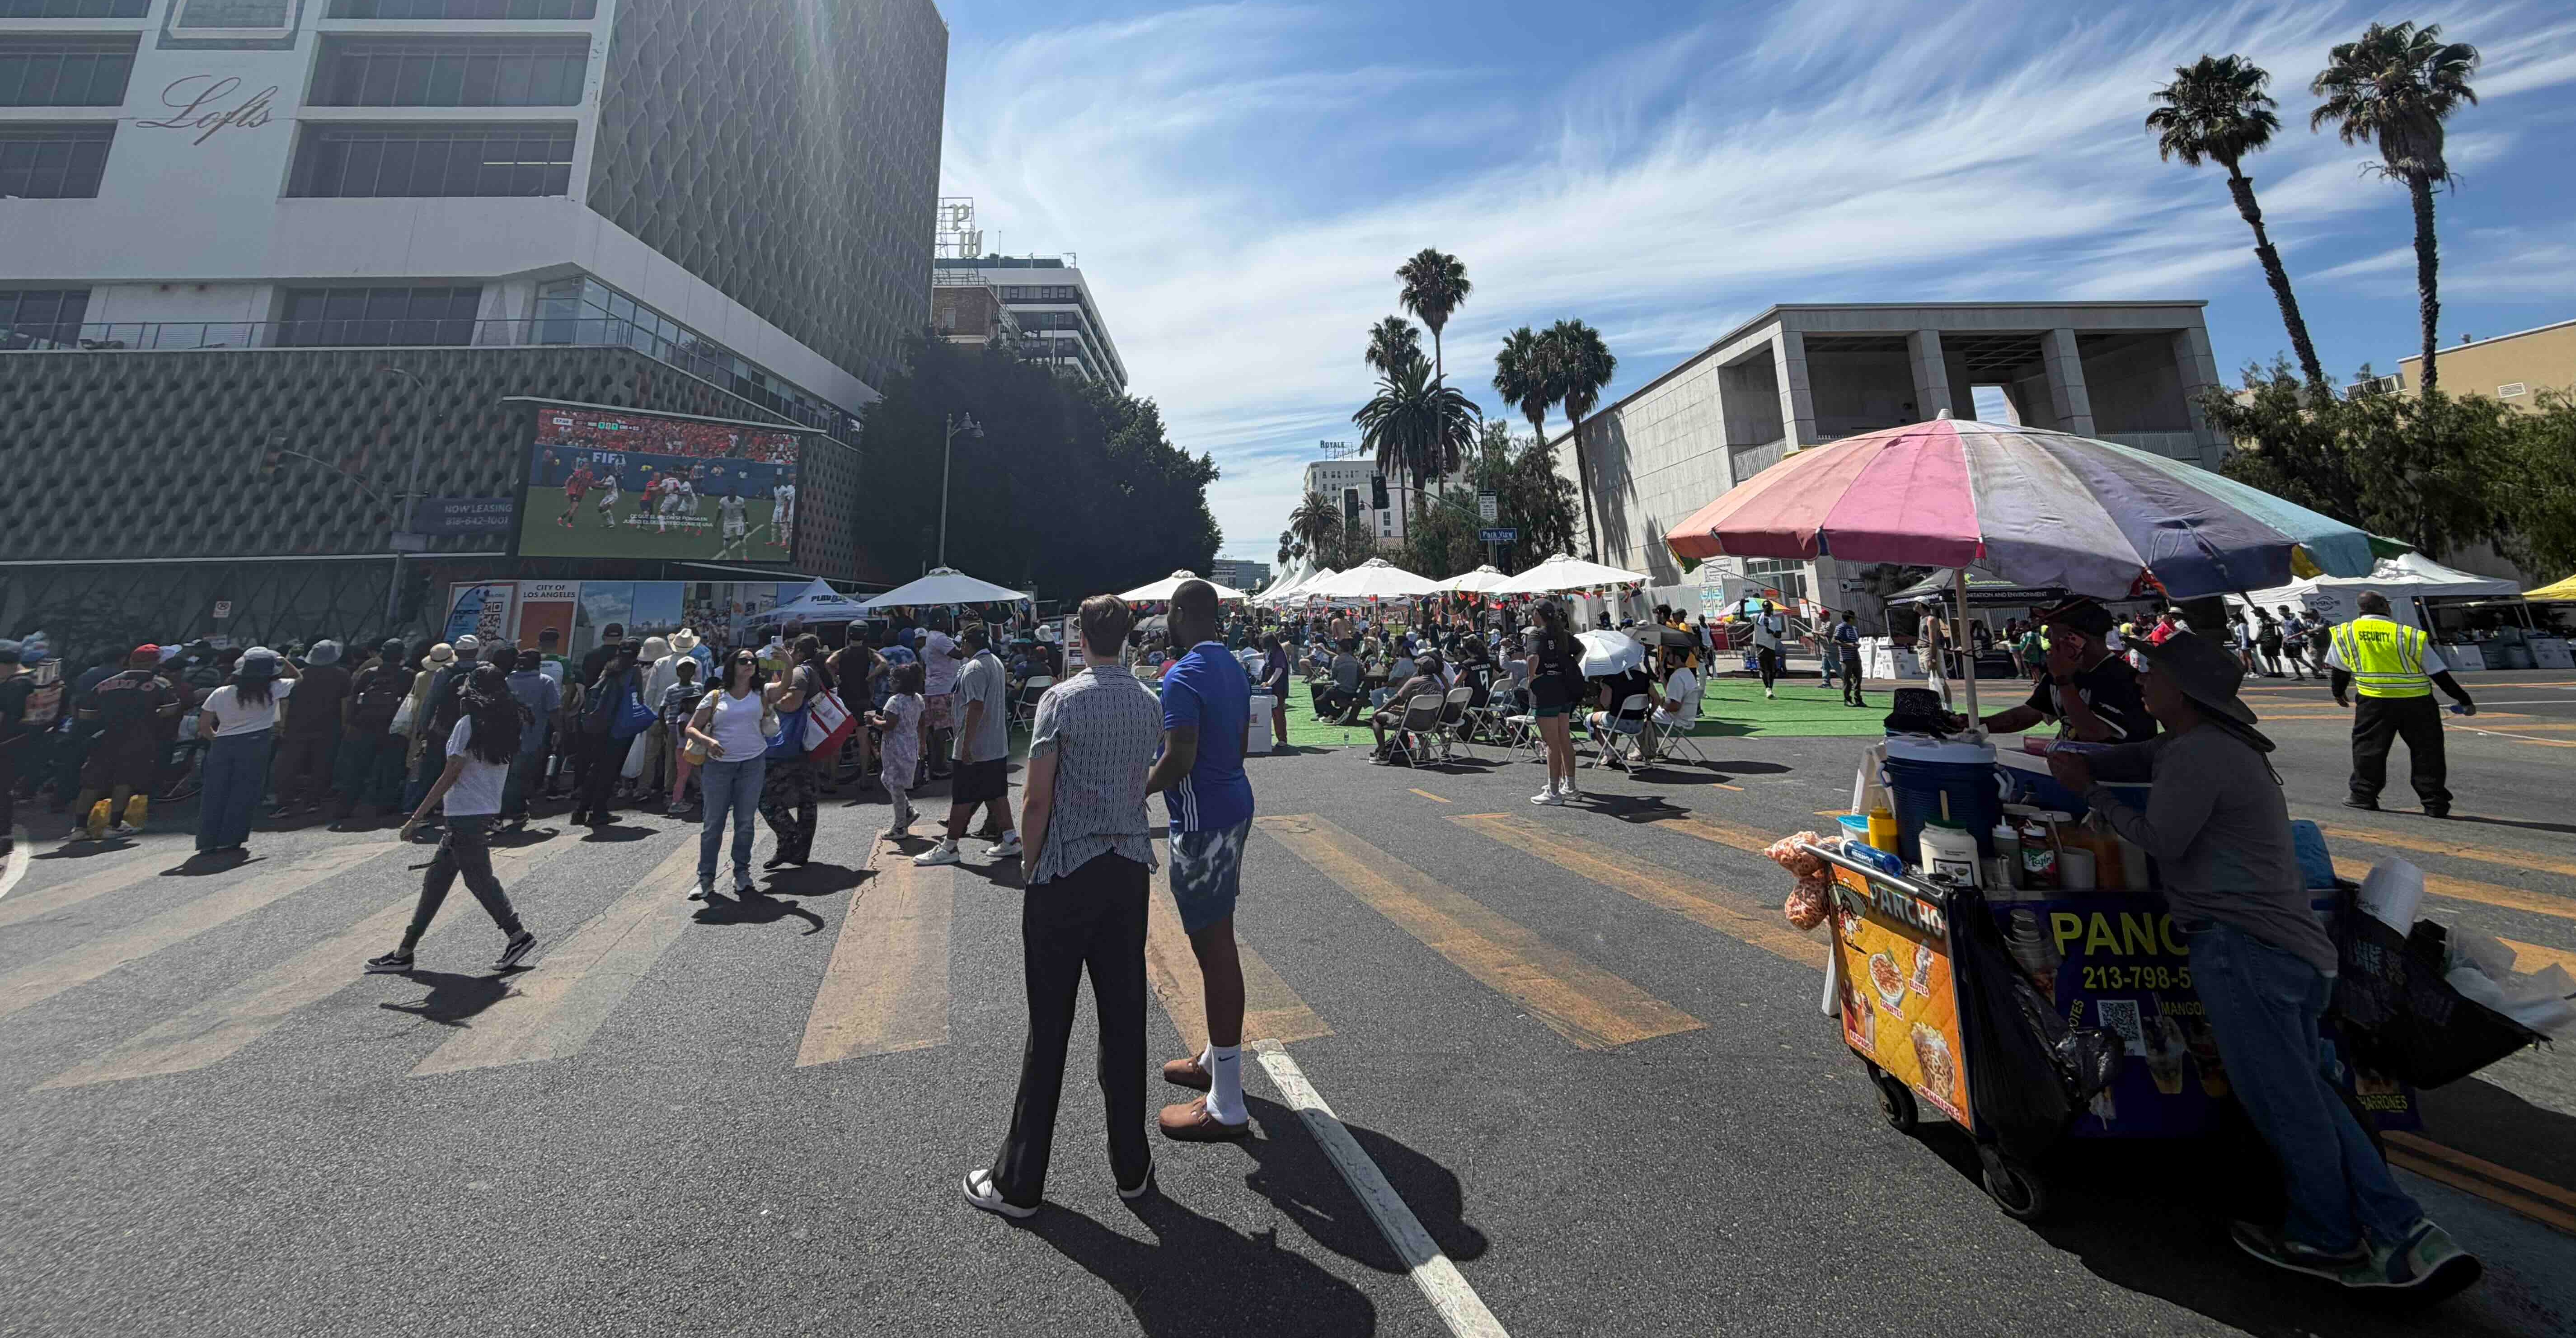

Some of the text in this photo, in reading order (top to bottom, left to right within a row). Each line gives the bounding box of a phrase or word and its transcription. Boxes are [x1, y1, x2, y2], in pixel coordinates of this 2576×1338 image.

[136, 75, 278, 145] Lofts
[949, 203, 969, 232] P
[1320, 440, 1345, 448] ROYALE
[445, 504, 513, 513] NOW LEASING
[1482, 530, 1514, 539] Park View
[2358, 630, 2390, 643] SECURITY
[1479, 670, 1489, 691] 9
[1869, 883, 1943, 937] PANCHO
[2082, 965, 2191, 990] 213-798-5
